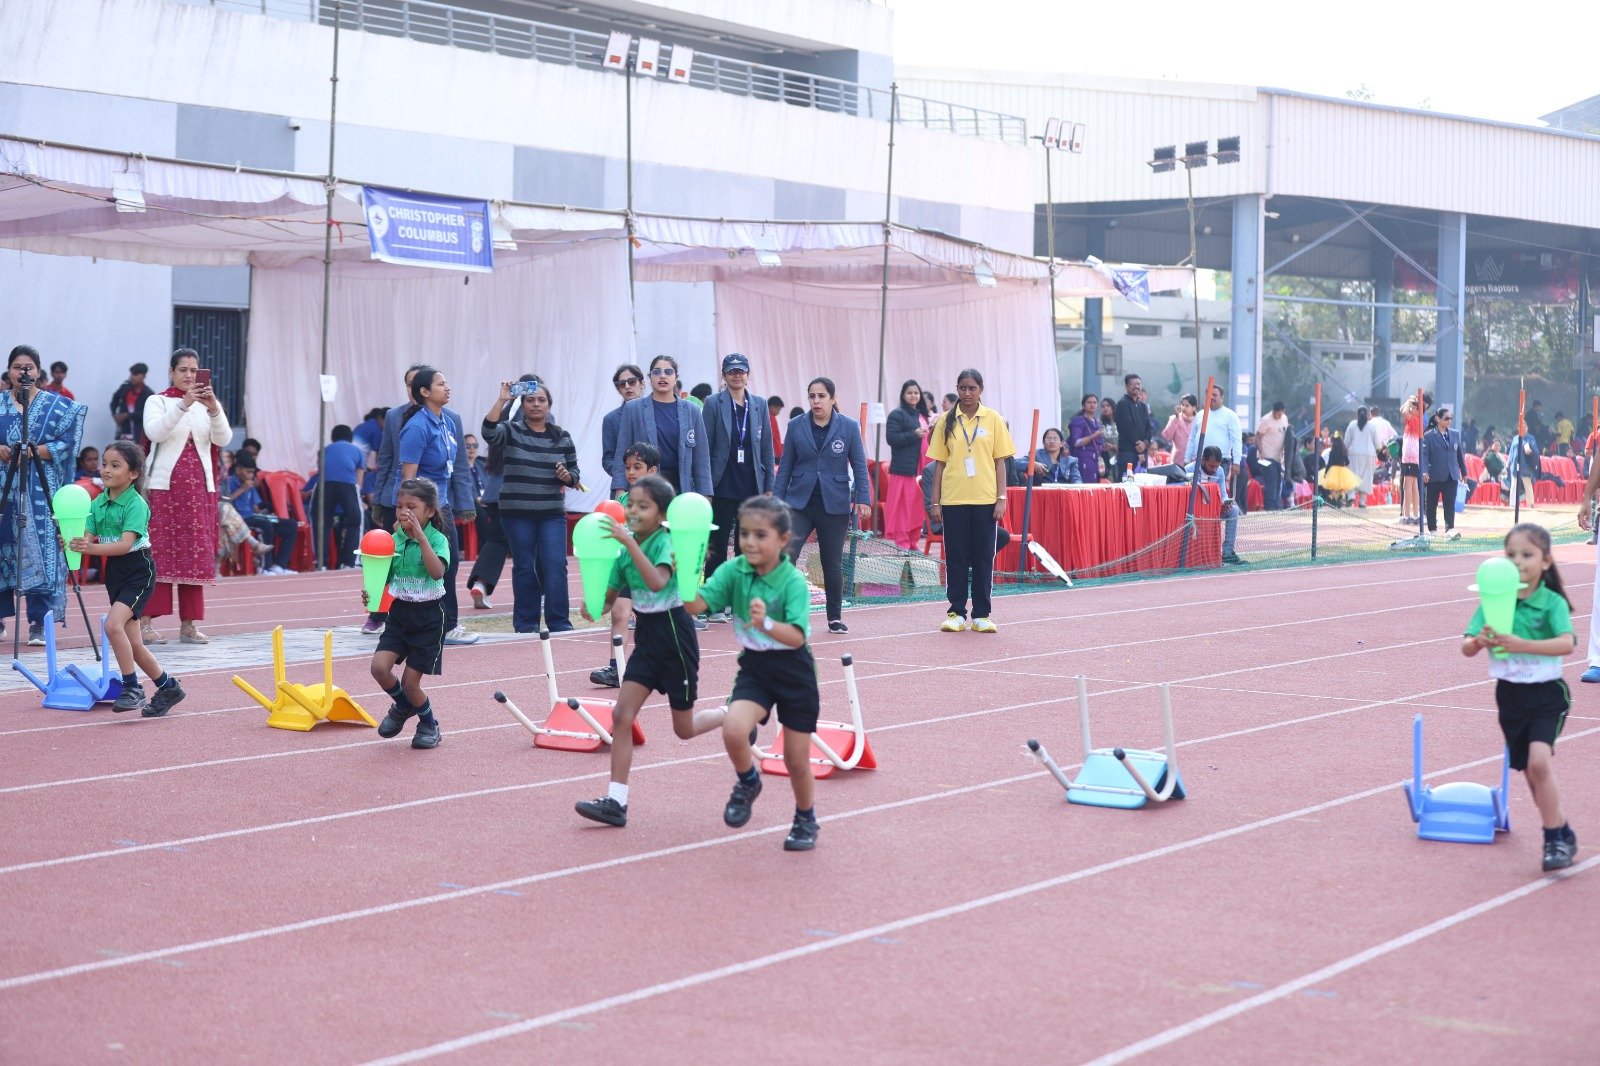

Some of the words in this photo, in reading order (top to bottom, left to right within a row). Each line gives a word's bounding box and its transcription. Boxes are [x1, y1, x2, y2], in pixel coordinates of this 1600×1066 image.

[389, 206, 466, 227] CHRISTOPHER
[398, 225, 458, 244] COLUMBUS
[1487, 284, 1520, 294] Raptors
